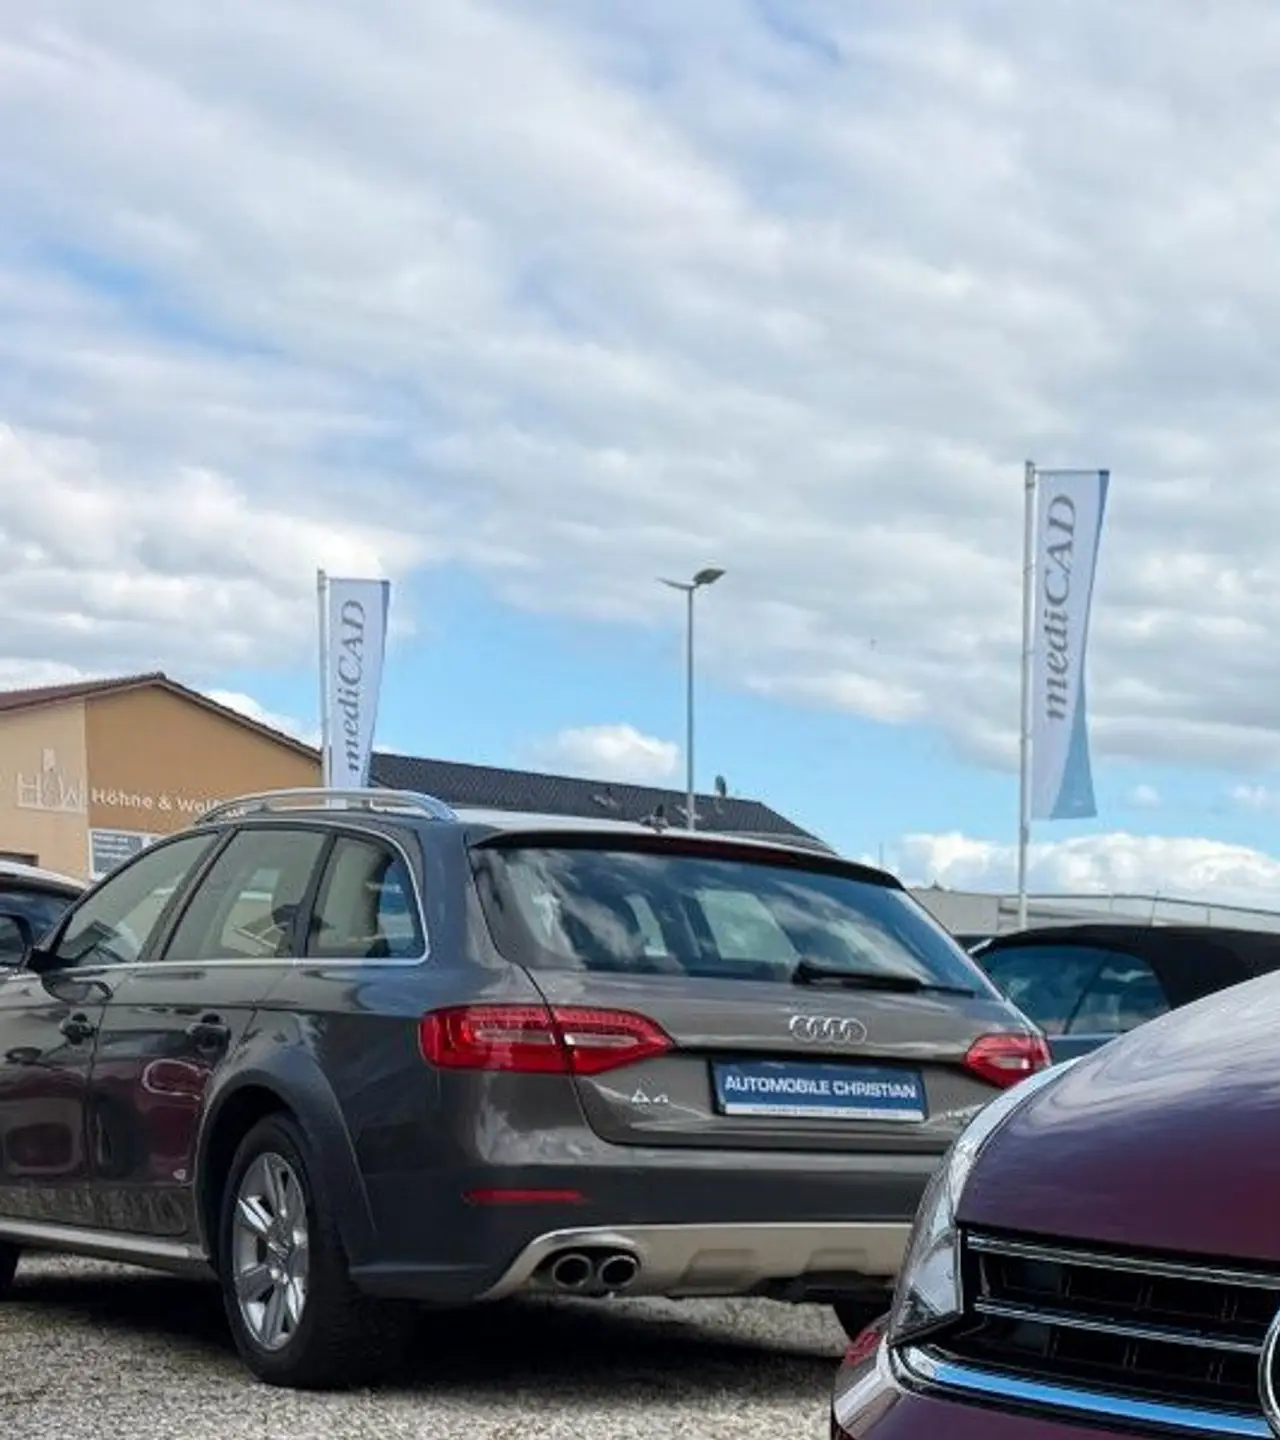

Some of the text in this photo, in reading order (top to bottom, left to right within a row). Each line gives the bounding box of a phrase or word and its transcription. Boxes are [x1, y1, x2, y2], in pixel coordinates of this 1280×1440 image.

[337, 600, 366, 772] mediCAD
[1044, 494, 1076, 721] mediCAD
[725, 1074, 917, 1099] AUTOMOBILE CHRISTIAN
